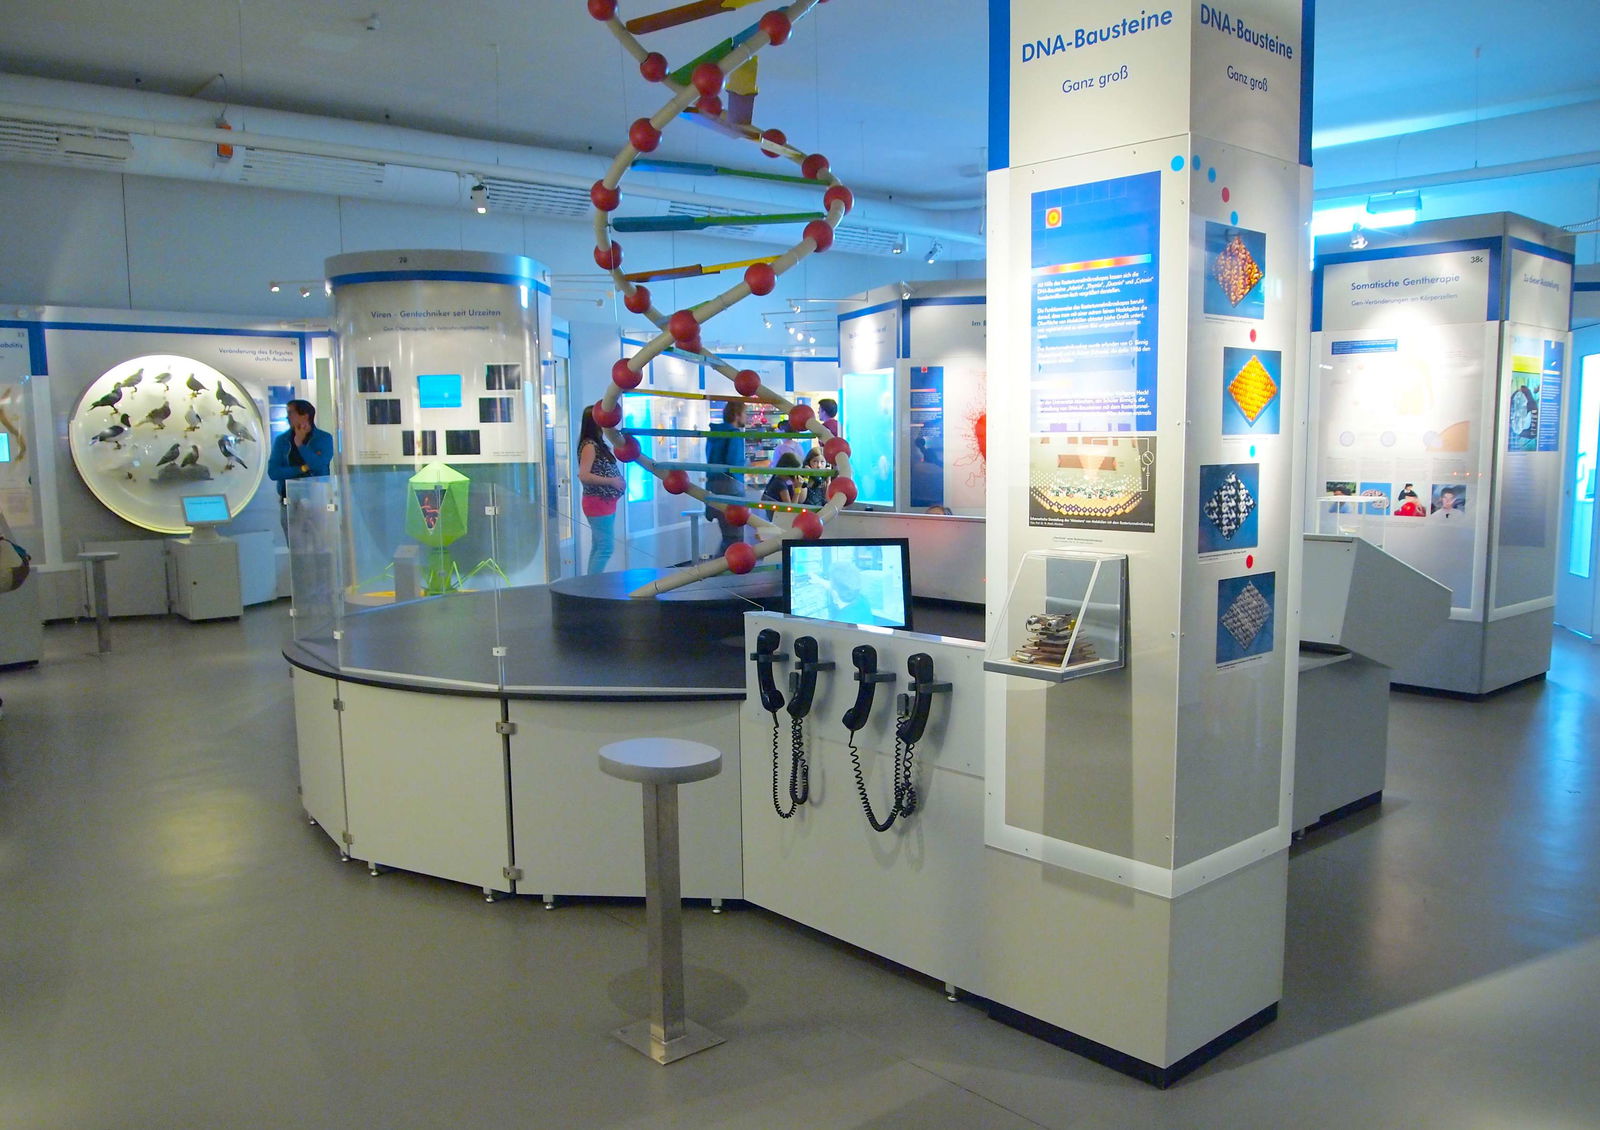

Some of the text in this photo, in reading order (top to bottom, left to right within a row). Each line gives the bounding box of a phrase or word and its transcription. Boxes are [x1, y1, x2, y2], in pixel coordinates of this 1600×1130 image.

[1022, 9, 1173, 63] DNA-Bausteine
[1200, 3, 1293, 60] DNA-Bausteine
[1062, 65, 1129, 94] Ganz groß
[1227, 65, 1268, 92] Ganz groß
[1470, 256, 1484, 264] 38c
[1351, 274, 1461, 291] Somatische Gentherapie
[371, 311, 392, 319] Viren
[400, 310, 450, 319] Gentechniker
[468, 309, 501, 317] Urzeiten
[219, 347, 257, 356] Veränderung
